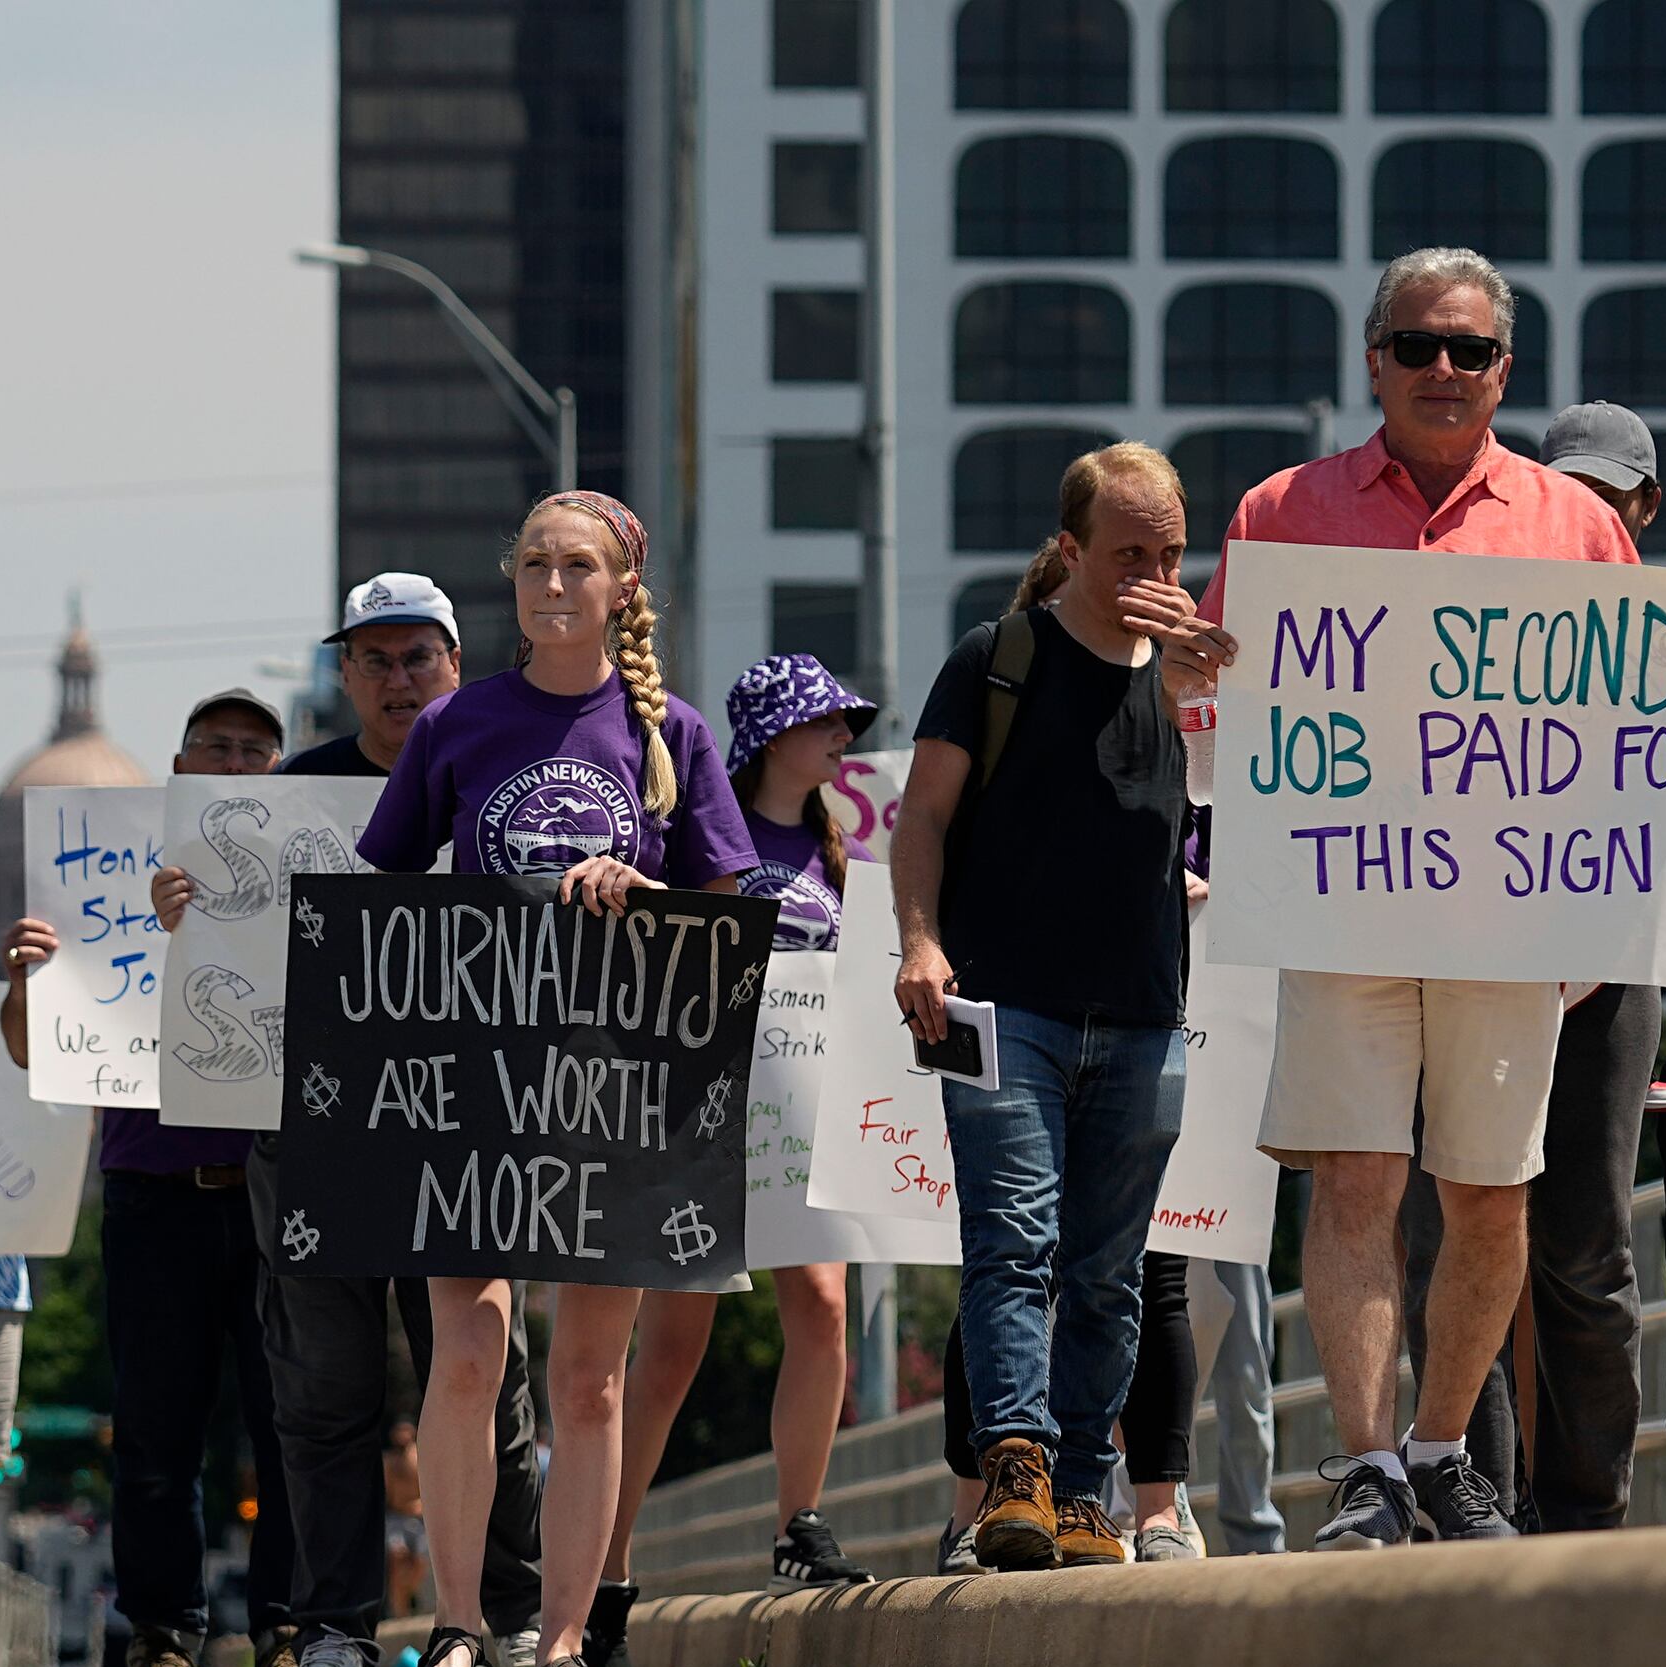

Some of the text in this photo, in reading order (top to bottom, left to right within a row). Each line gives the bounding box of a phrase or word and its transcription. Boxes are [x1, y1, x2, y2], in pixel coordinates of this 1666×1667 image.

[1270, 606, 1389, 693] MY
[1250, 705, 1372, 798] JOB
[1419, 711, 1582, 800] PAID
[484, 763, 634, 836] AUSTIN NEWSGUILD
[54, 806, 165, 887] Honk
[1290, 823, 1652, 898] THIS SIGN
[339, 902, 741, 1048] JOURNALISTS
[55, 1014, 110, 1055] We
[86, 1062, 143, 1097] fair
[367, 1045, 669, 1152] ARE WORTH
[859, 1096, 920, 1144] Fair
[411, 1150, 608, 1260] MORE
[891, 1154, 952, 1208] Stop
